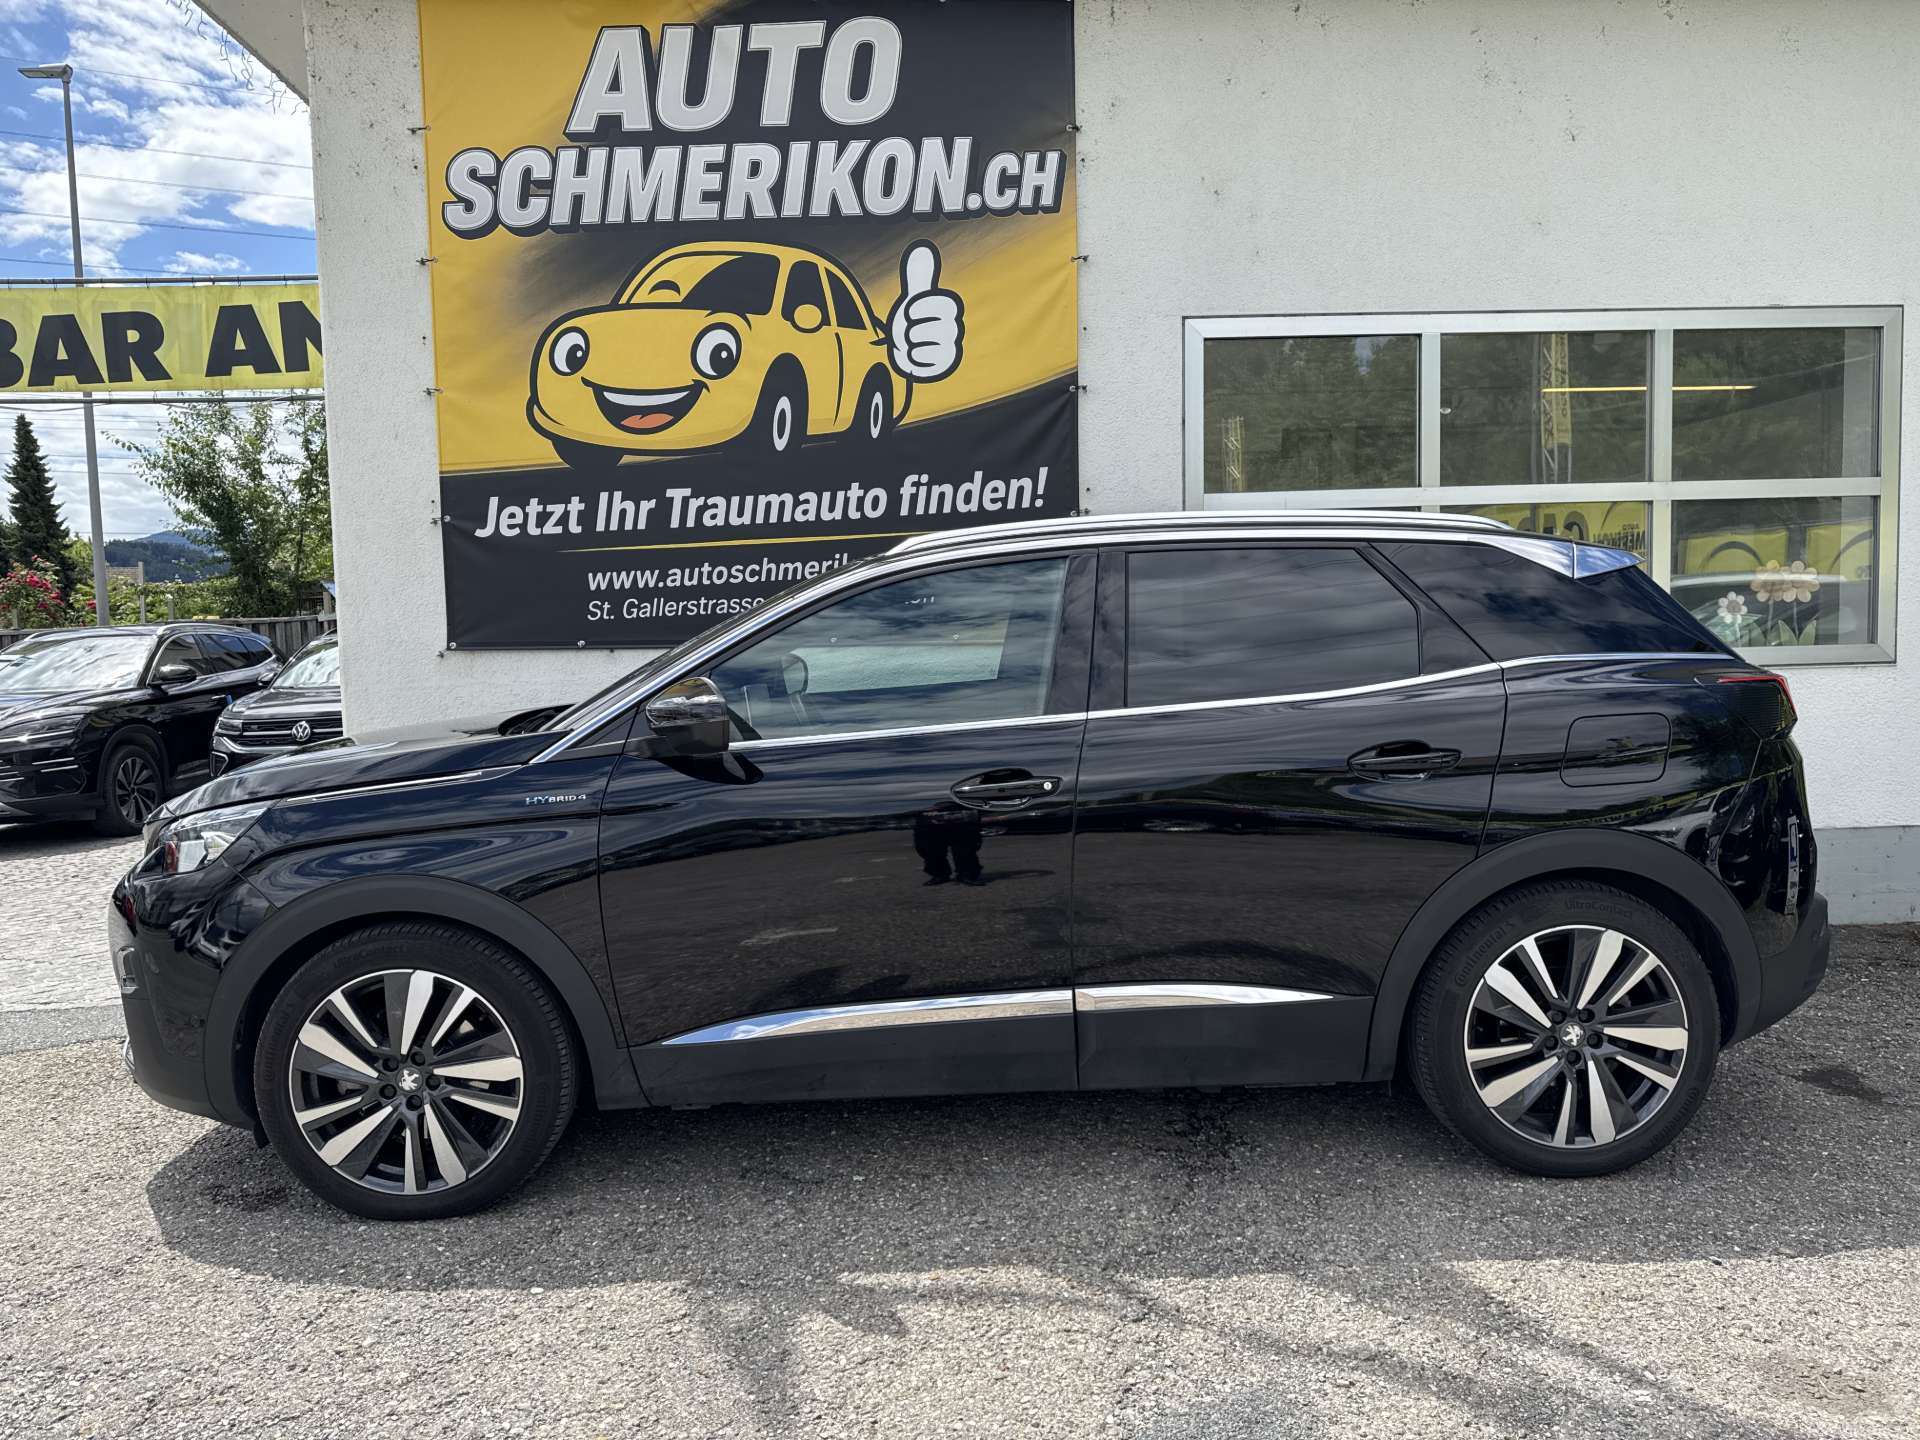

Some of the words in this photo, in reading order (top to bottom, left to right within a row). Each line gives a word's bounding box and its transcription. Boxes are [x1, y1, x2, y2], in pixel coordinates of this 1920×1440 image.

[565, 15, 903, 137] AUTO
[443, 136, 1062, 233] SCHMERIKON.CH
[474, 496, 584, 538] Jetzt
[595, 490, 656, 532] Ihr
[665, 480, 888, 530] Traumauto
[898, 466, 1049, 517] finden!
[587, 600, 614, 621] St.
[525, 793, 587, 805] HYBRID4
